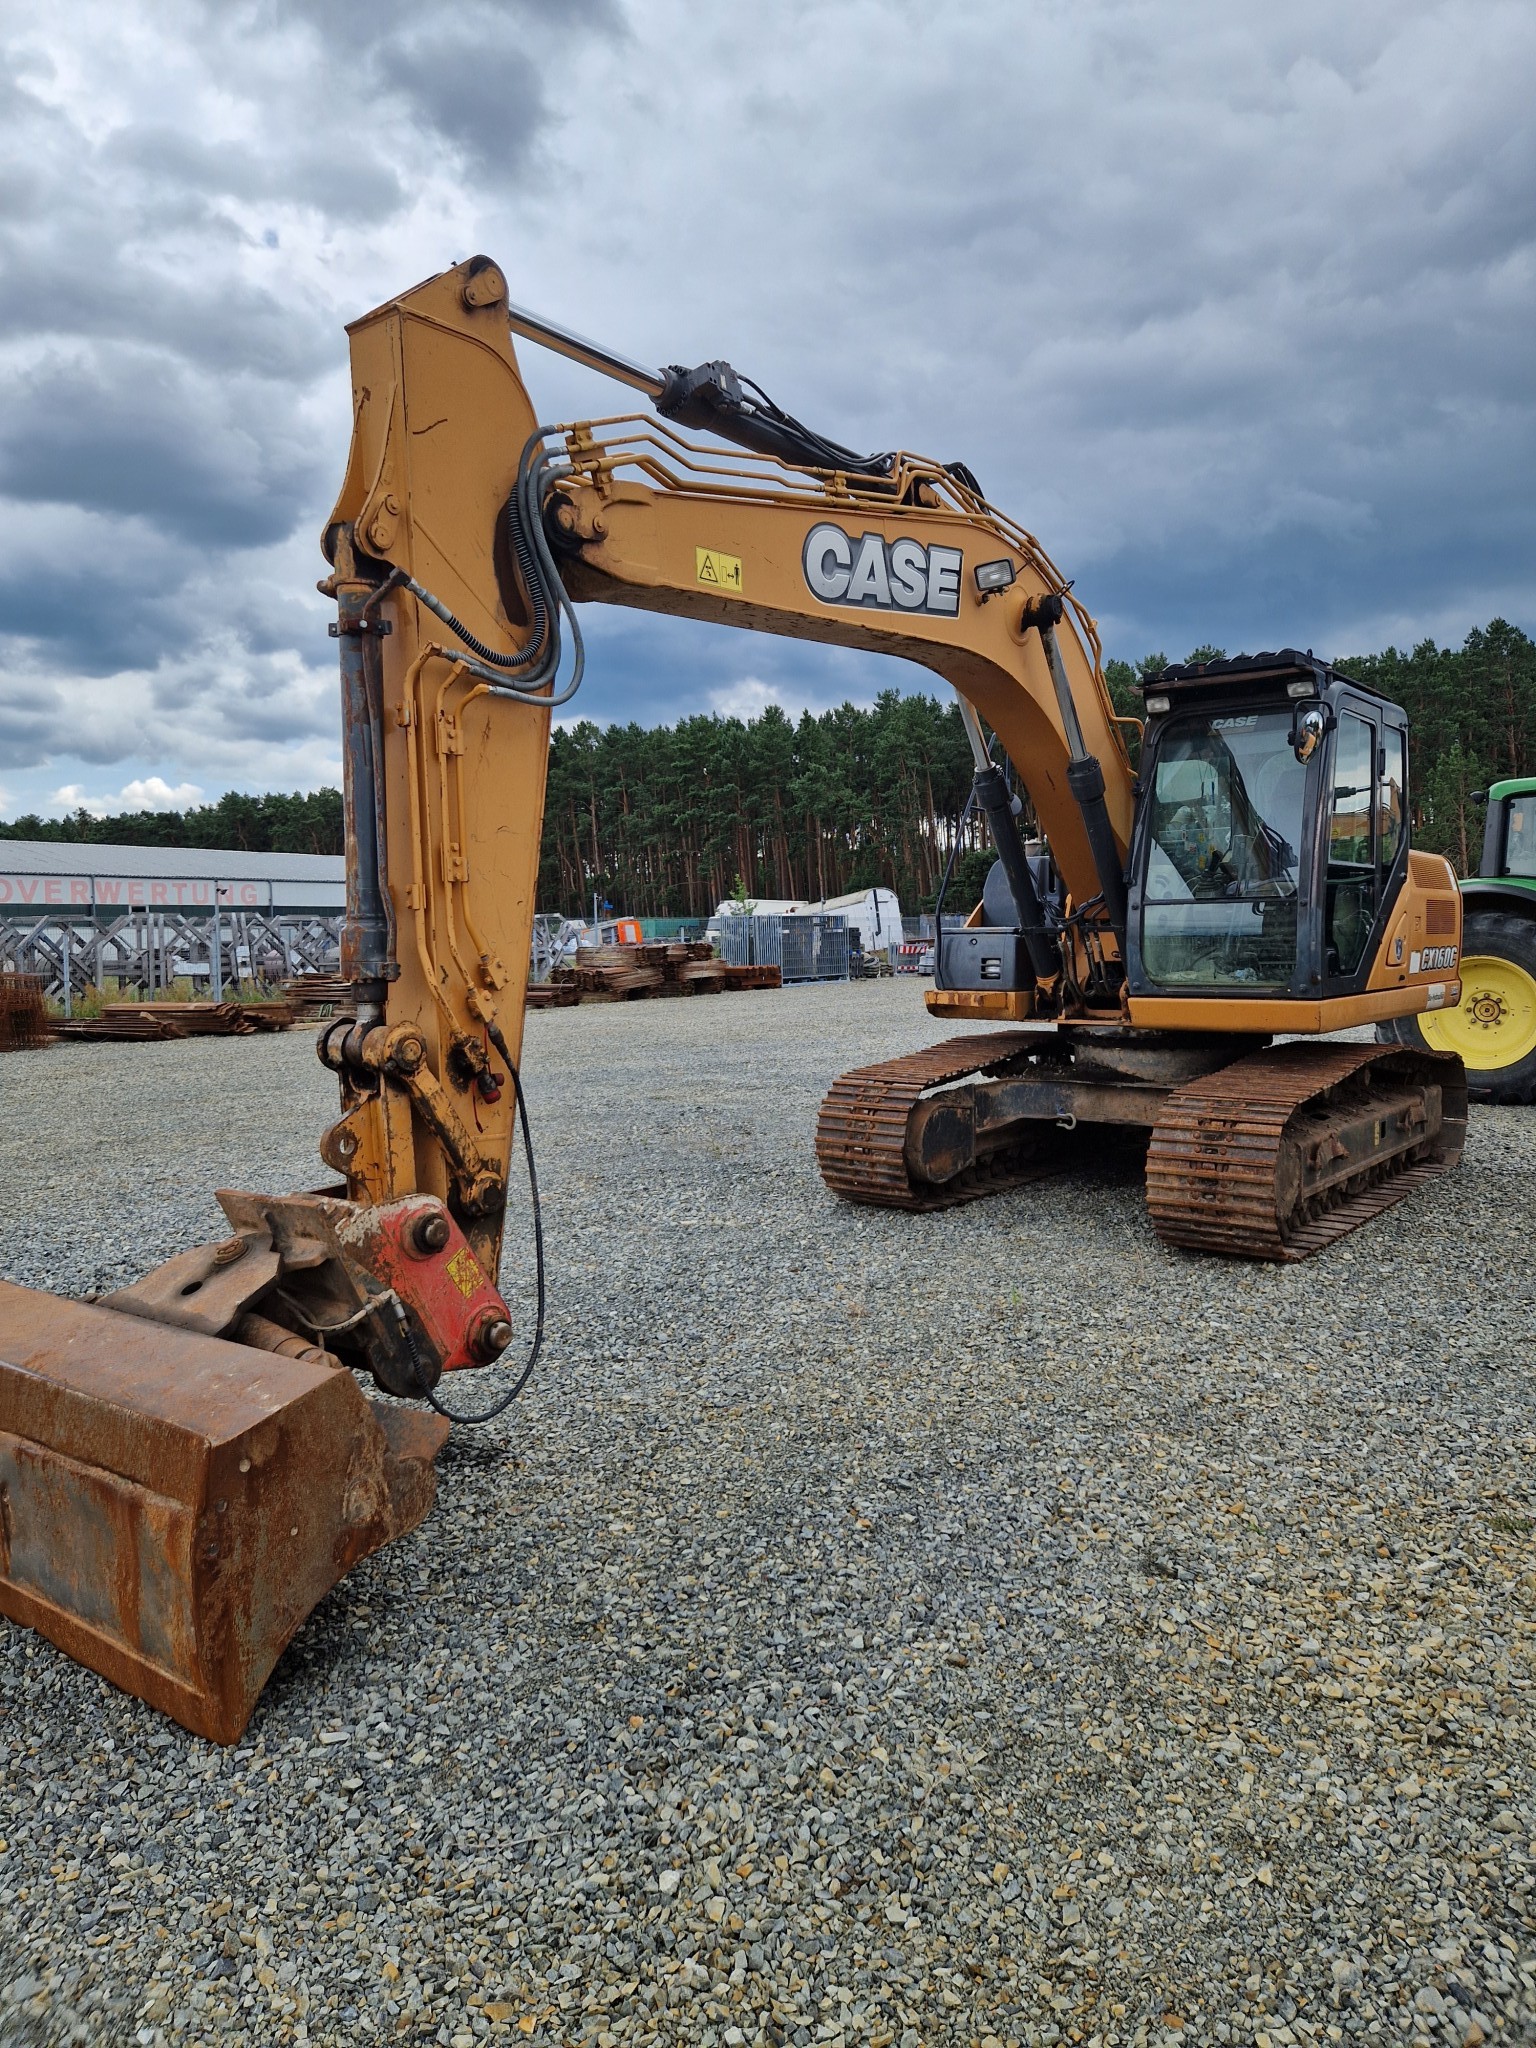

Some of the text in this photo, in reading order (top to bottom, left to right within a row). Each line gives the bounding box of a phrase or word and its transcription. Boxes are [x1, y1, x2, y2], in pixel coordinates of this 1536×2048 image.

[804, 525, 962, 613] CASE
[1212, 715, 1258, 729] CASE
[1421, 946, 1457, 970] CX160C
